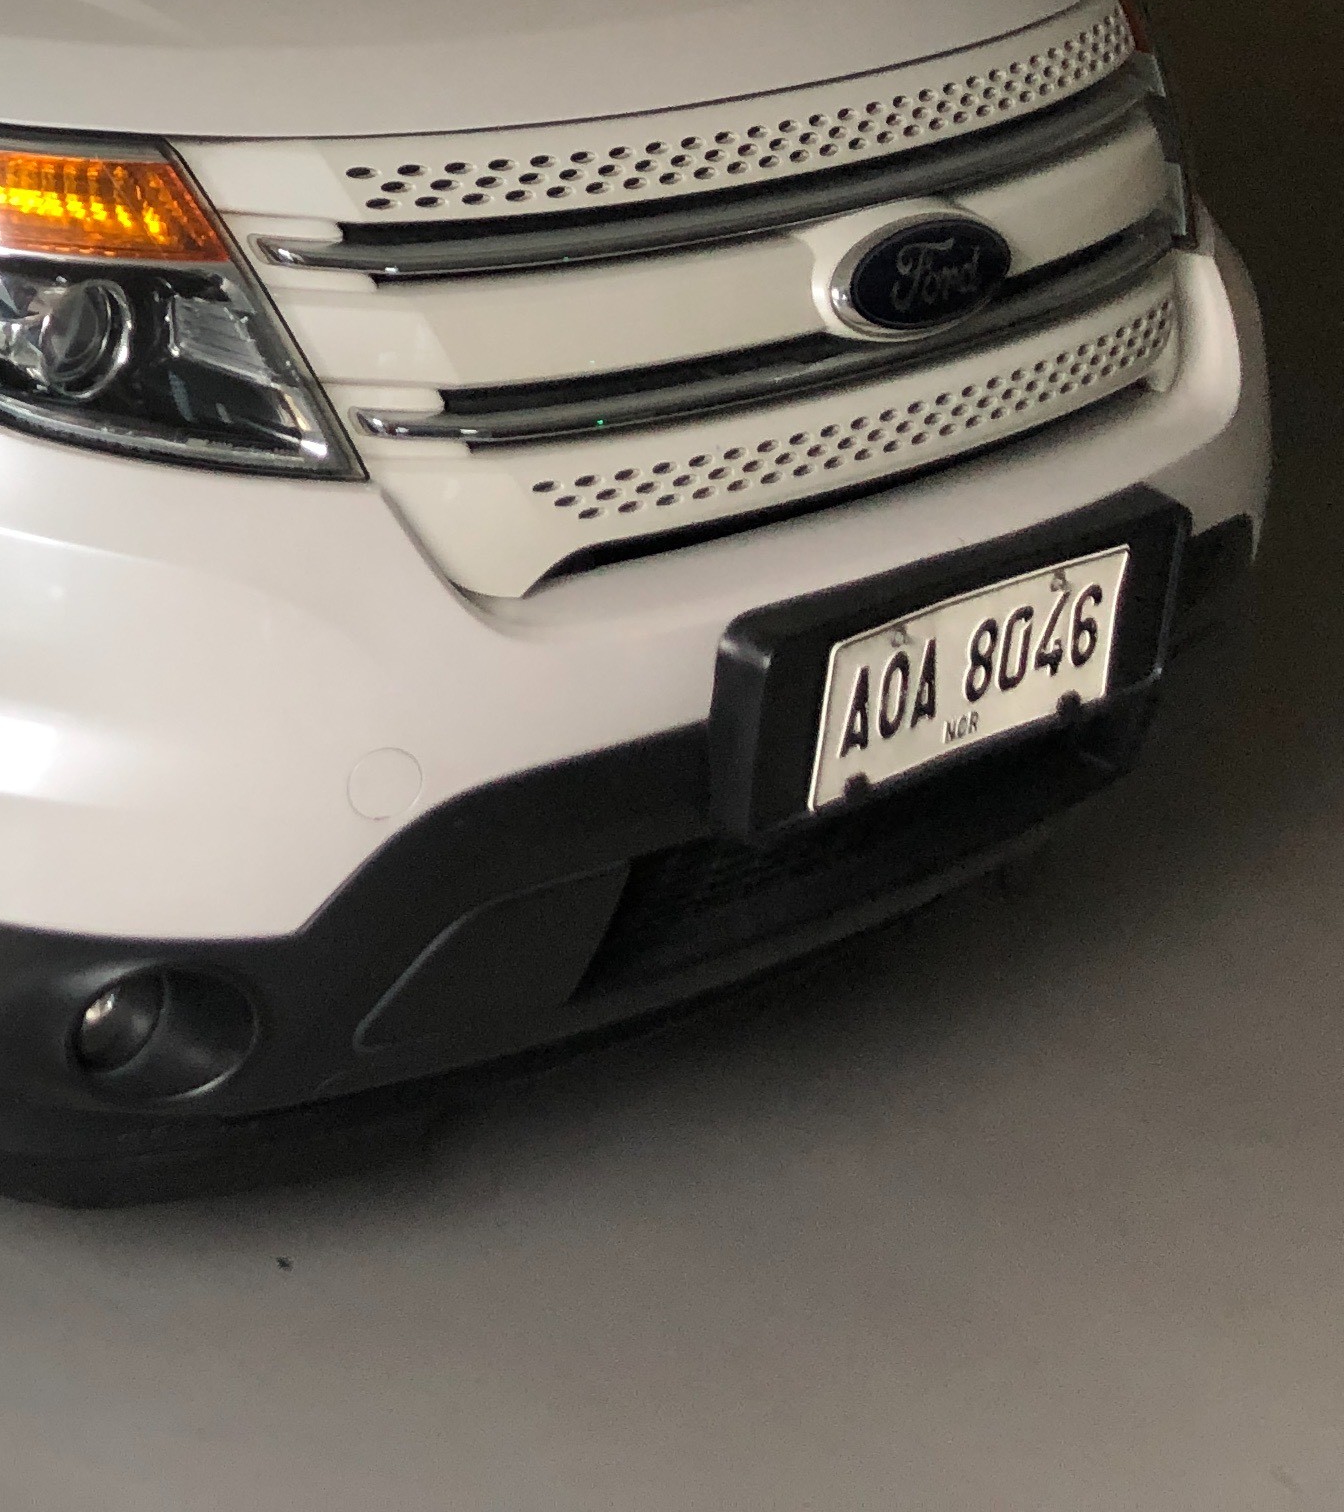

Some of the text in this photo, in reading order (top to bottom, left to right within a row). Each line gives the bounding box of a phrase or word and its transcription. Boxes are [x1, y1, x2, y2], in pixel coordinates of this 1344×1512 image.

[891, 238, 980, 312] Ford
[838, 583, 1103, 759] AOA 8046
[944, 710, 980, 745] NCR
